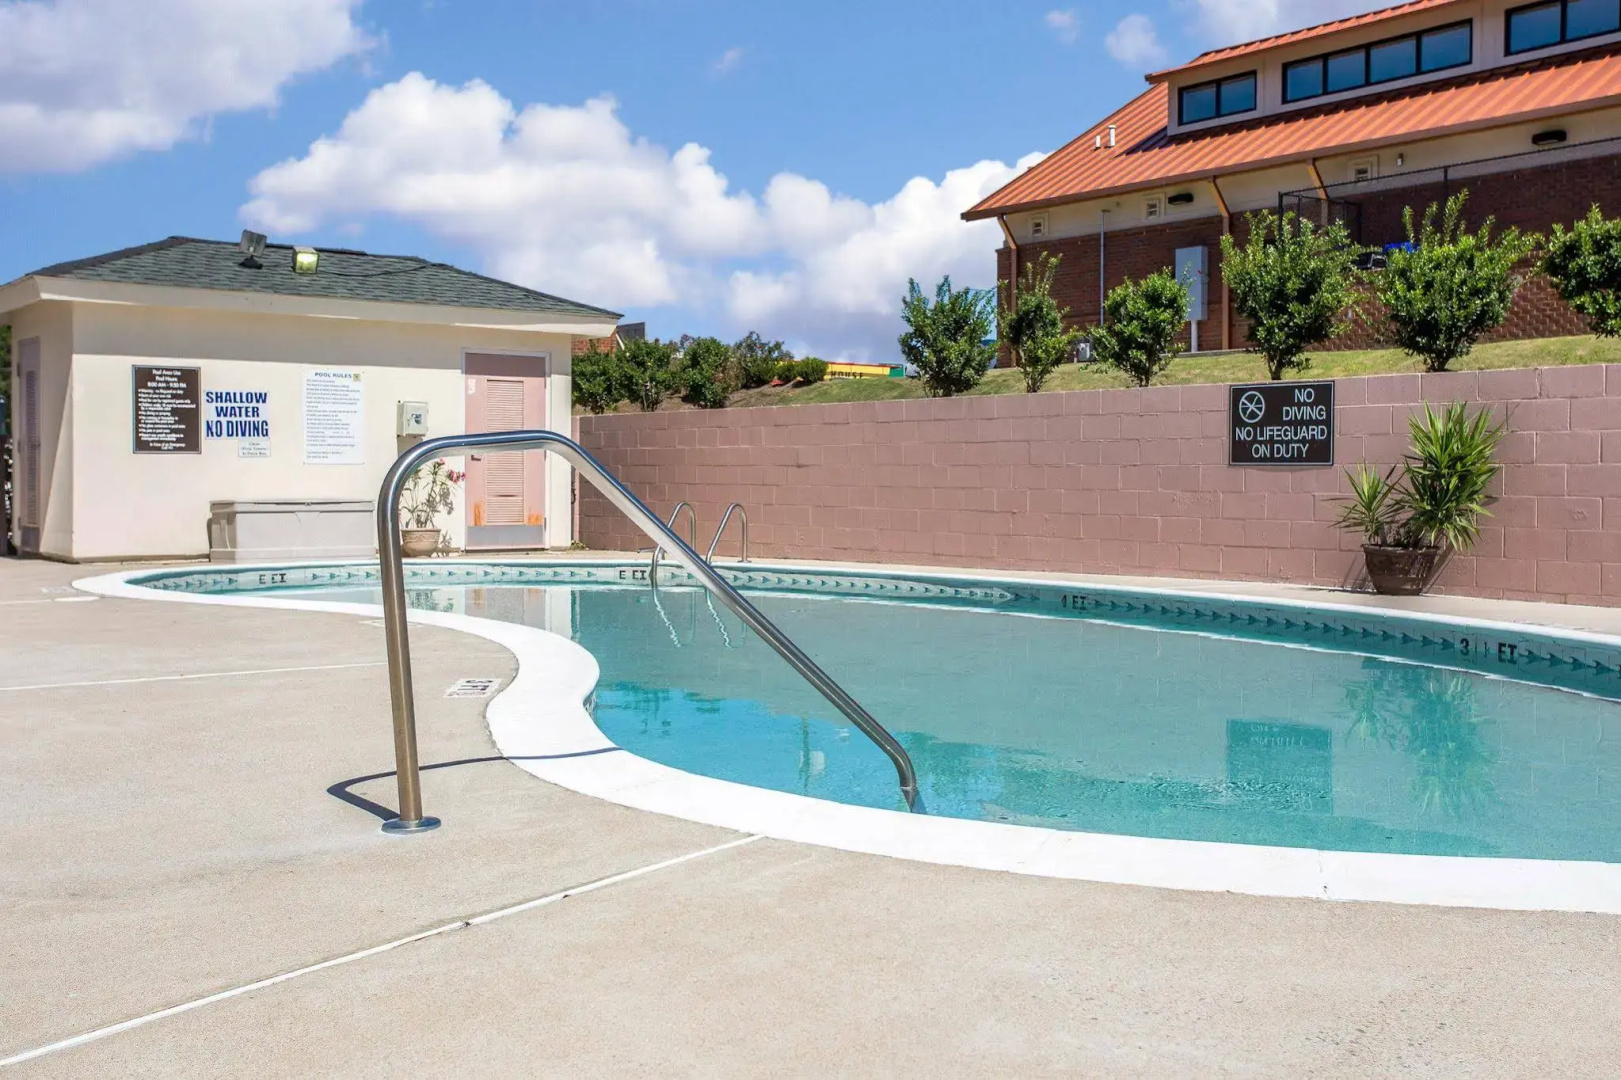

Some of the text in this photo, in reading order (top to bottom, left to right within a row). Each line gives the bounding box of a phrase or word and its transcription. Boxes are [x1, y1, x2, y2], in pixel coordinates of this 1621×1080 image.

[205, 391, 268, 404] SHALLOW
[1294, 388, 1315, 403] NO
[215, 405, 260, 418] WATER
[1282, 405, 1327, 421] DIVING
[206, 420, 269, 438] NO DIVING
[1235, 425, 1328, 441] NO LIFEGUARD
[1251, 443, 1309, 458] ON DUTY
